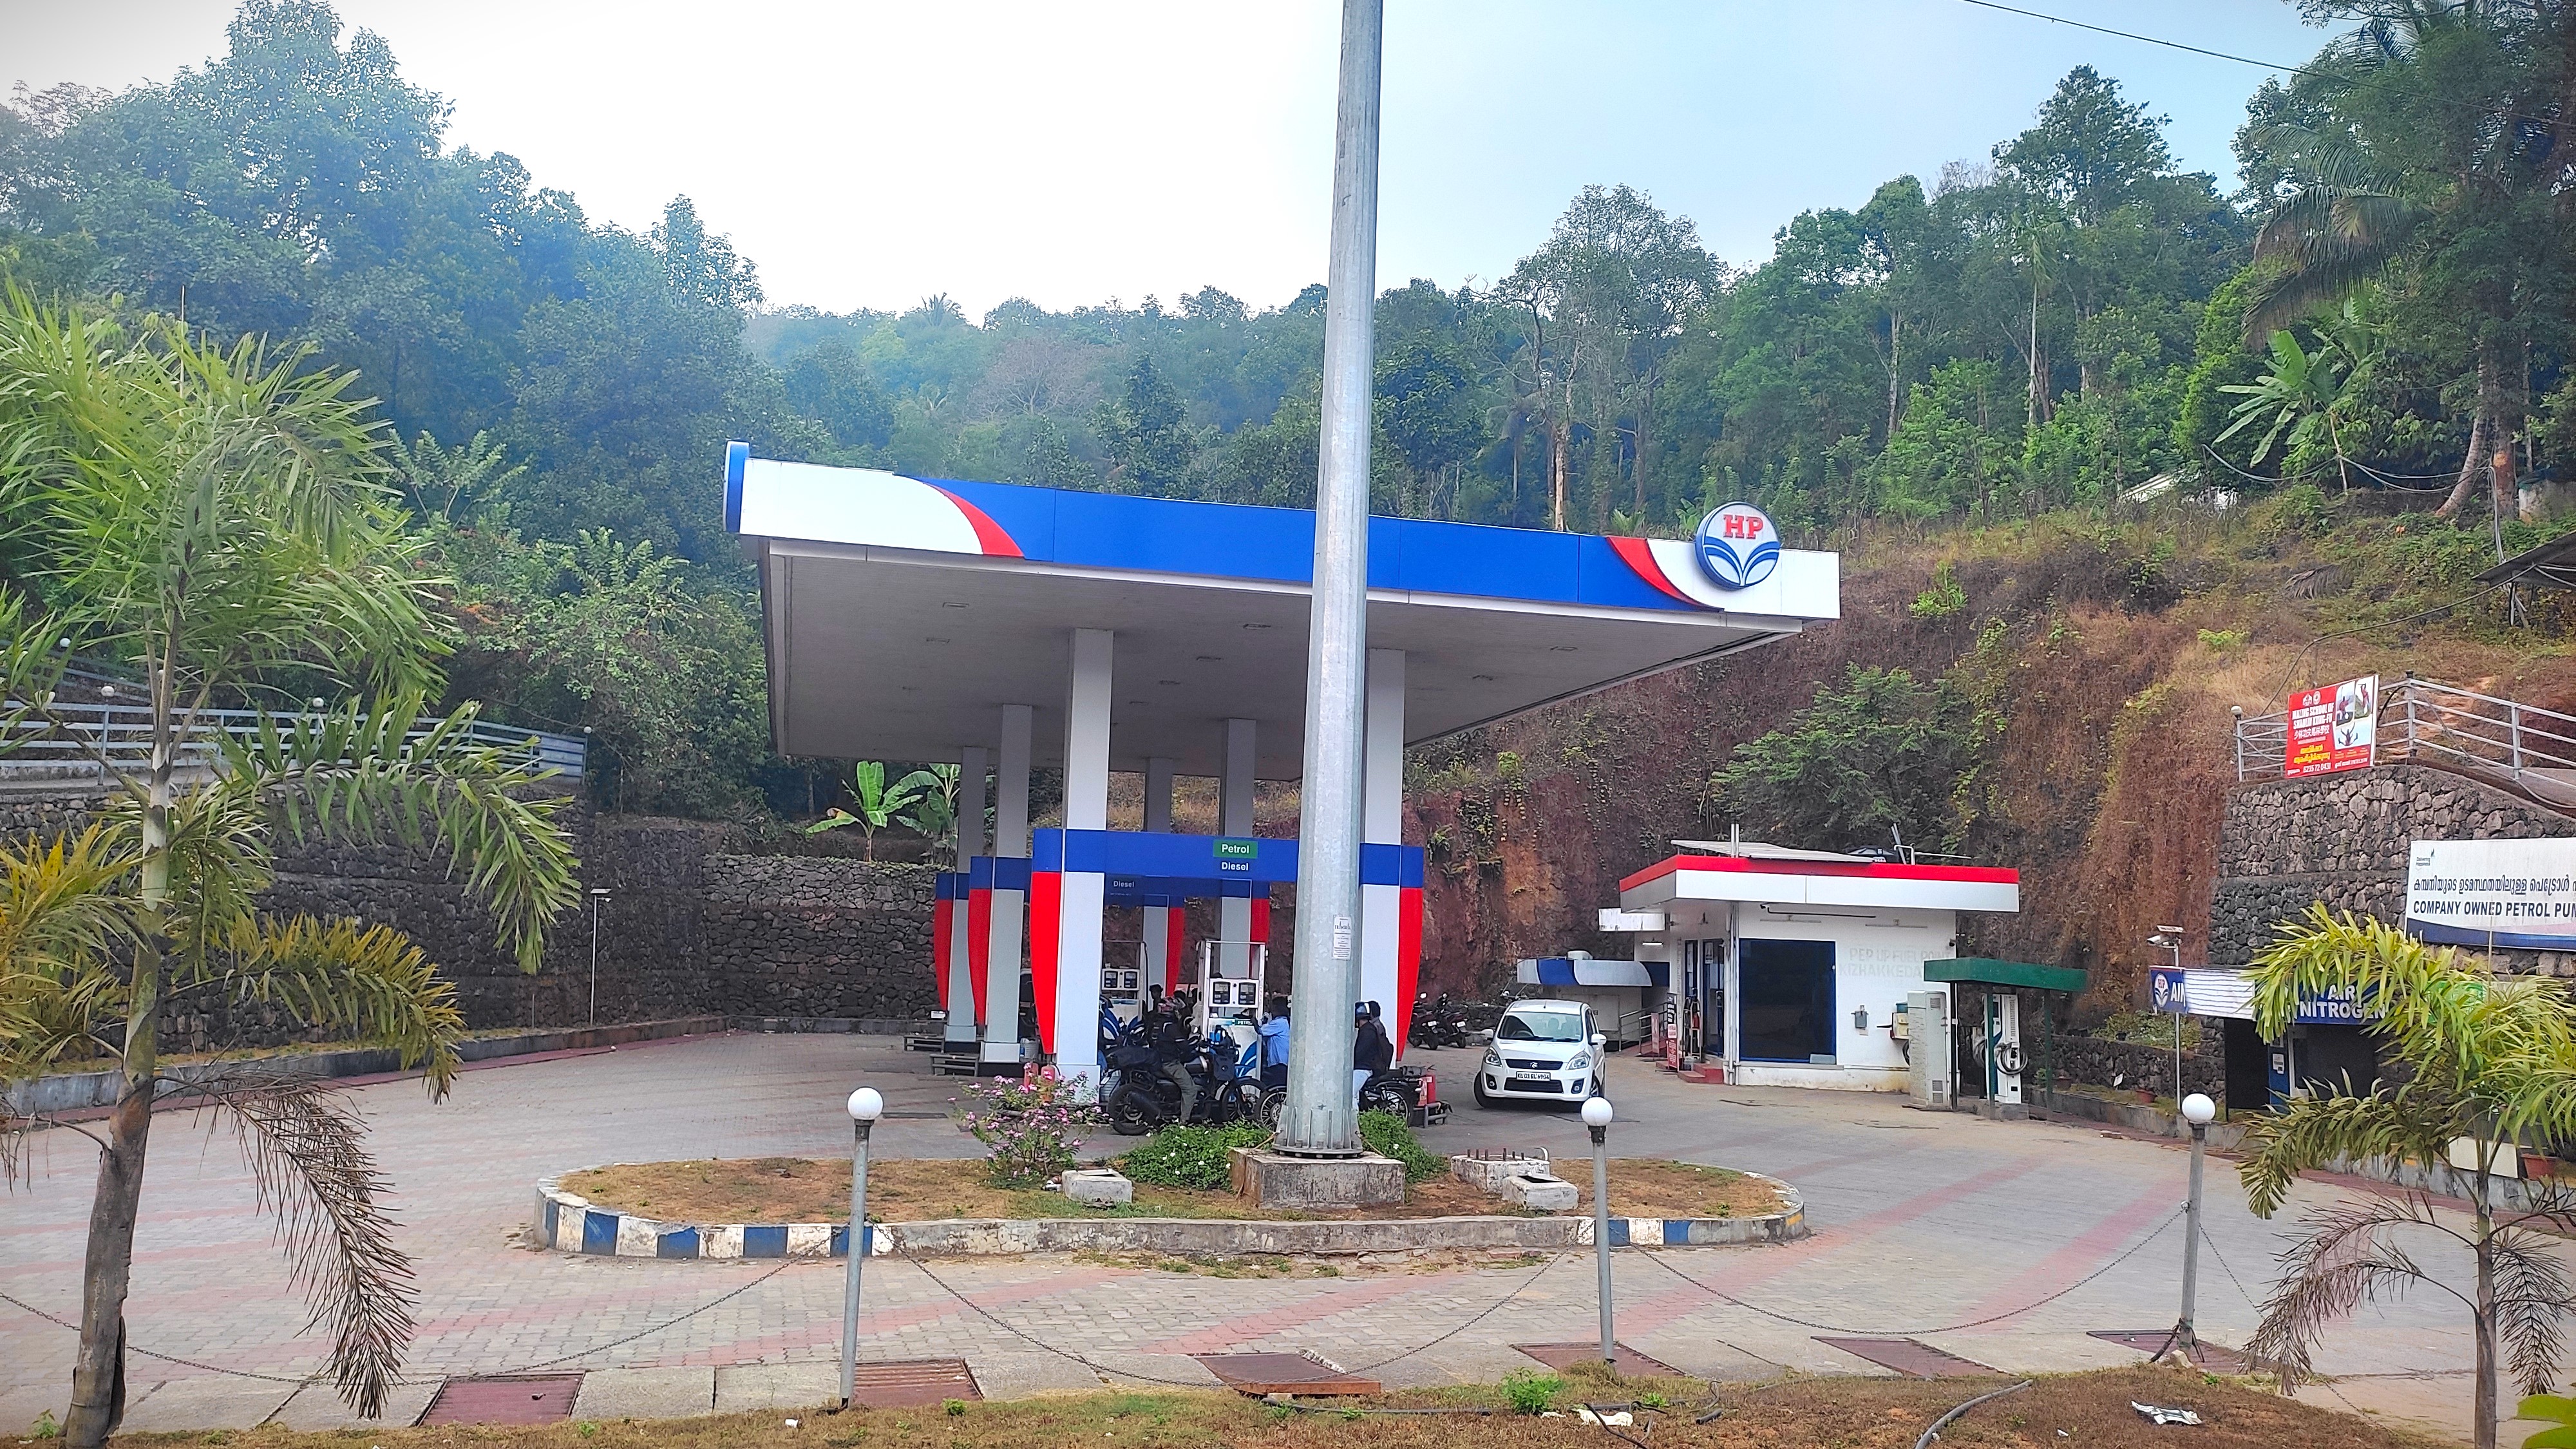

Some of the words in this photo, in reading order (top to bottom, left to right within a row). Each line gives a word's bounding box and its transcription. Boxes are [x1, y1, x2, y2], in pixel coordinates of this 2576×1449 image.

[1723, 514, 1763, 539] HP
[2328, 703, 2334, 713] OF
[1222, 844, 1249, 854] Petrol
[1222, 862, 1249, 871] Diesel
[2414, 900, 2461, 914] COMPANY
[2464, 902, 2503, 916] OWNED
[2506, 902, 2550, 917] PETROL
[2158, 978, 2165, 989] HP
